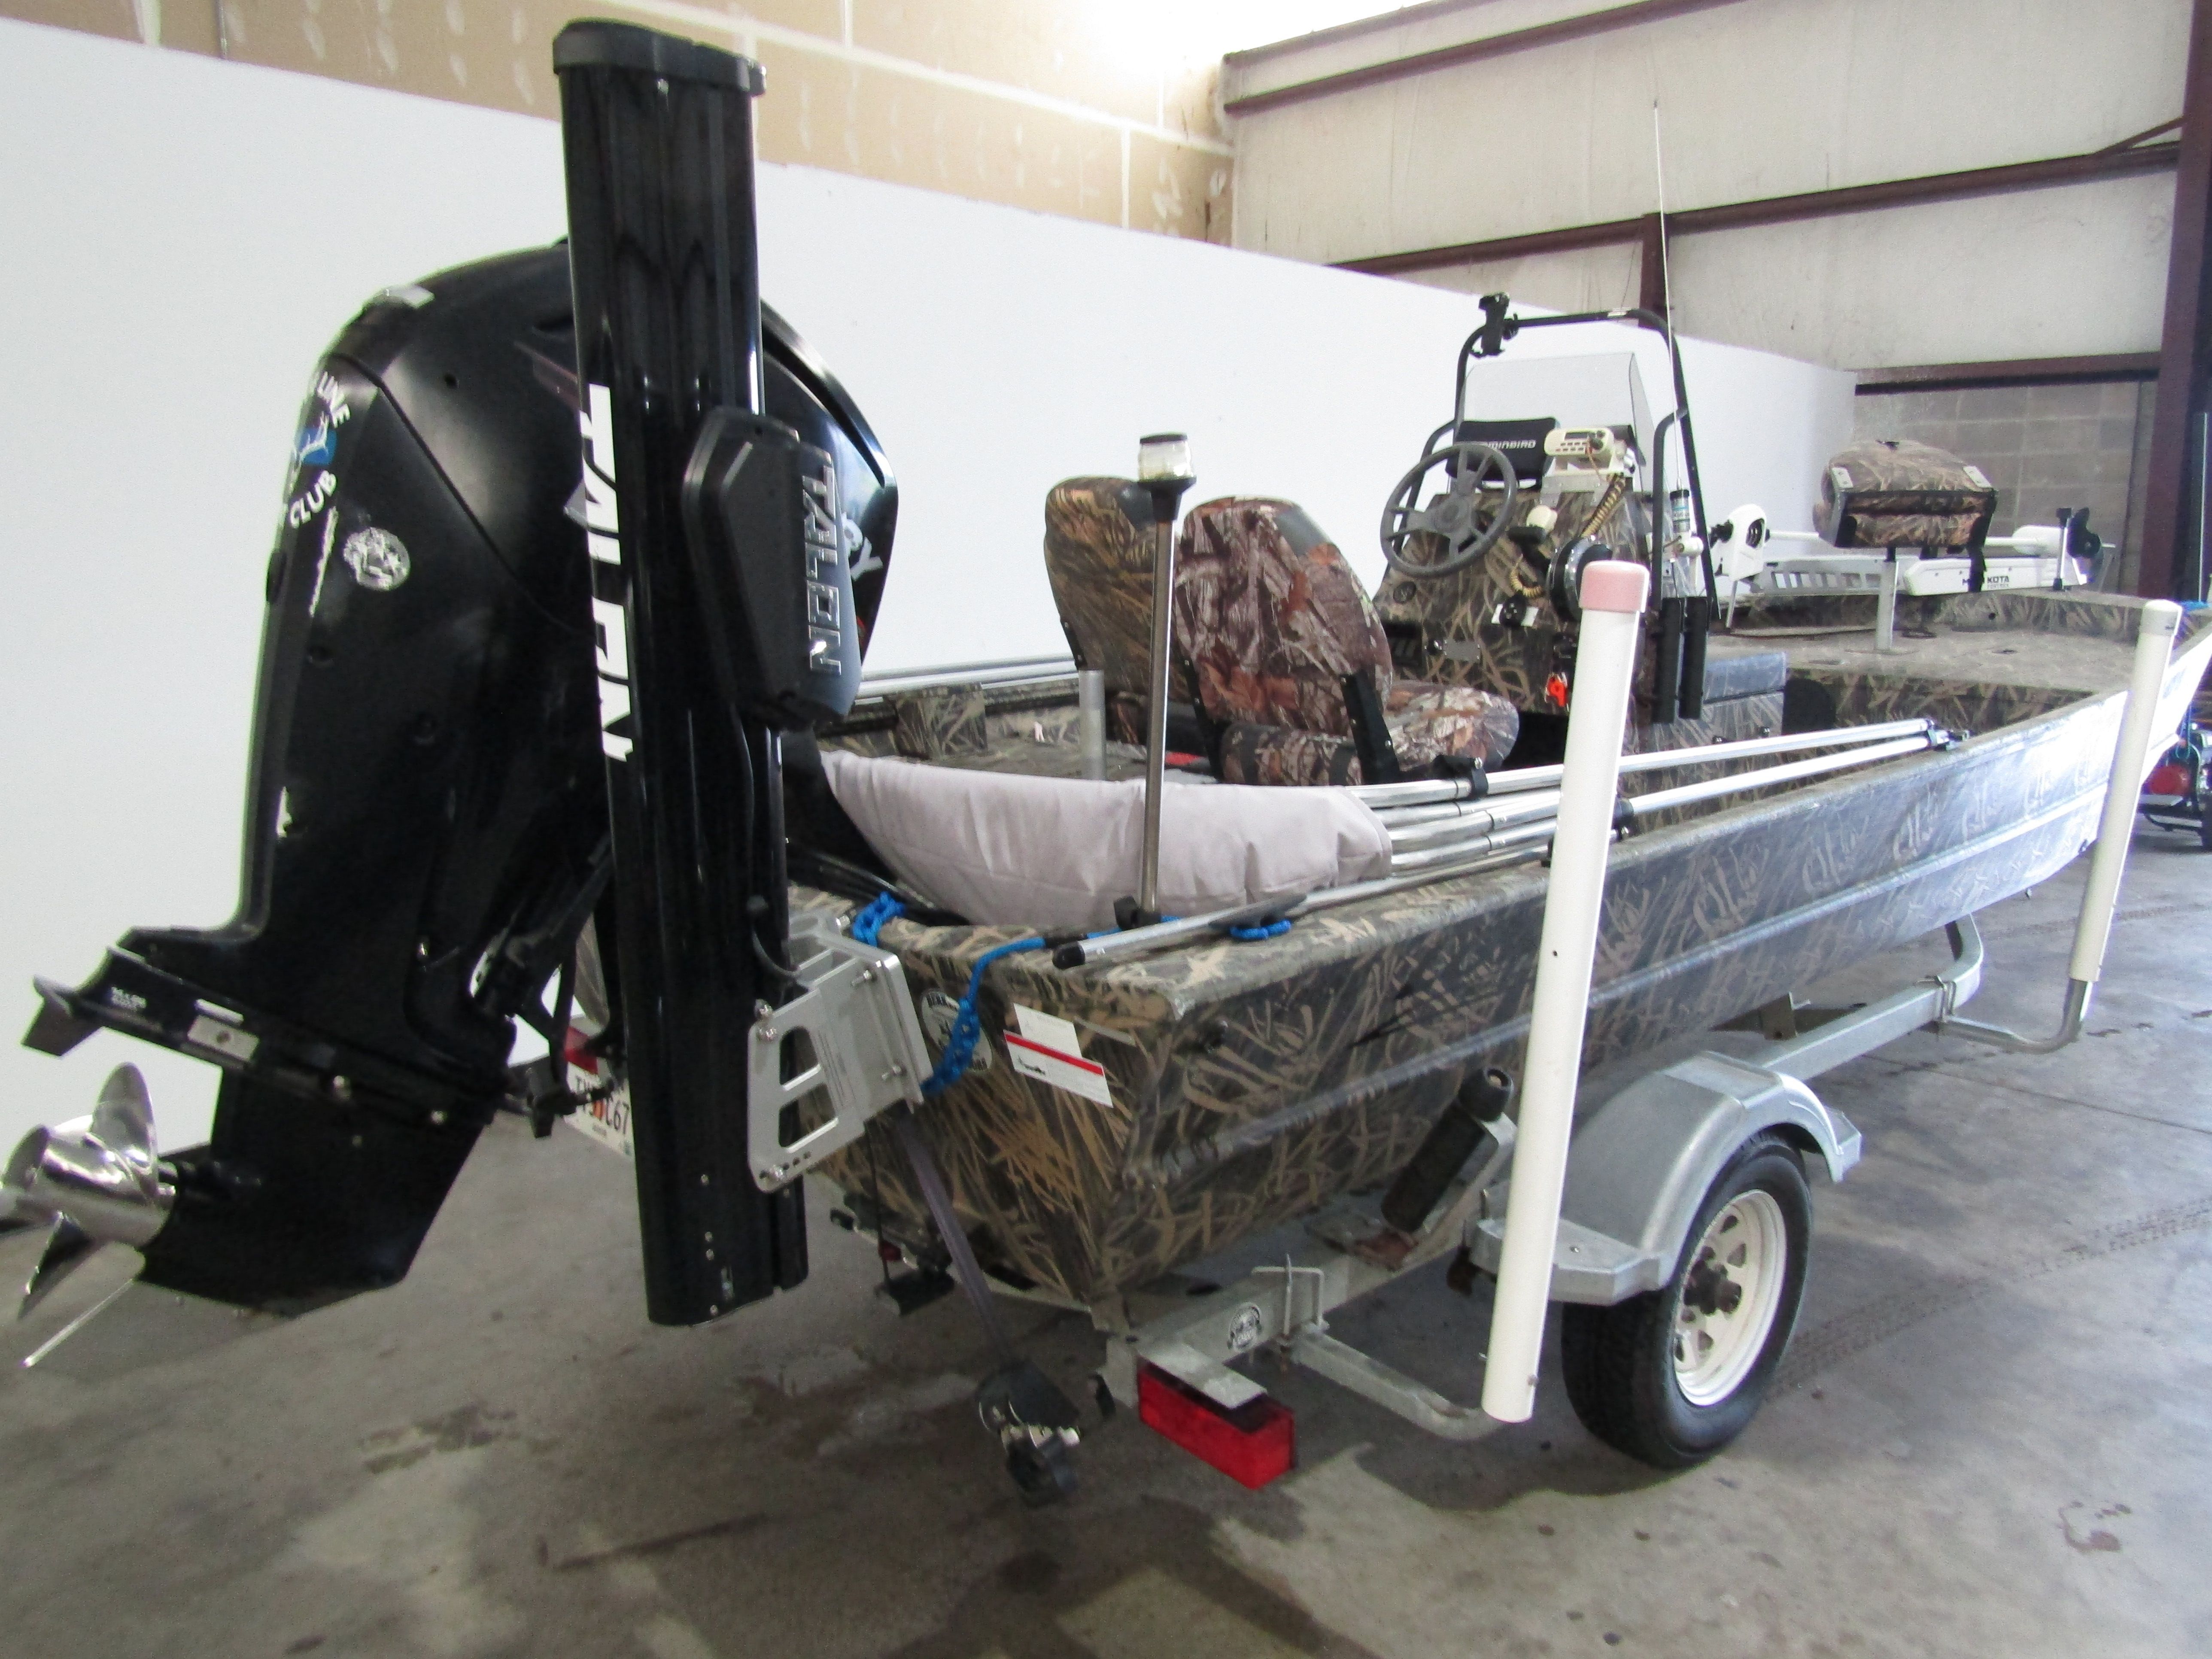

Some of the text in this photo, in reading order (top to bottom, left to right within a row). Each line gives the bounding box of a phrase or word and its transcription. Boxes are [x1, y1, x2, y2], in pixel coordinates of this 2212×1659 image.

[290, 470, 337, 529] CLUB
[802, 465, 842, 676] TALON
[1987, 575, 2009, 584] KOTA
